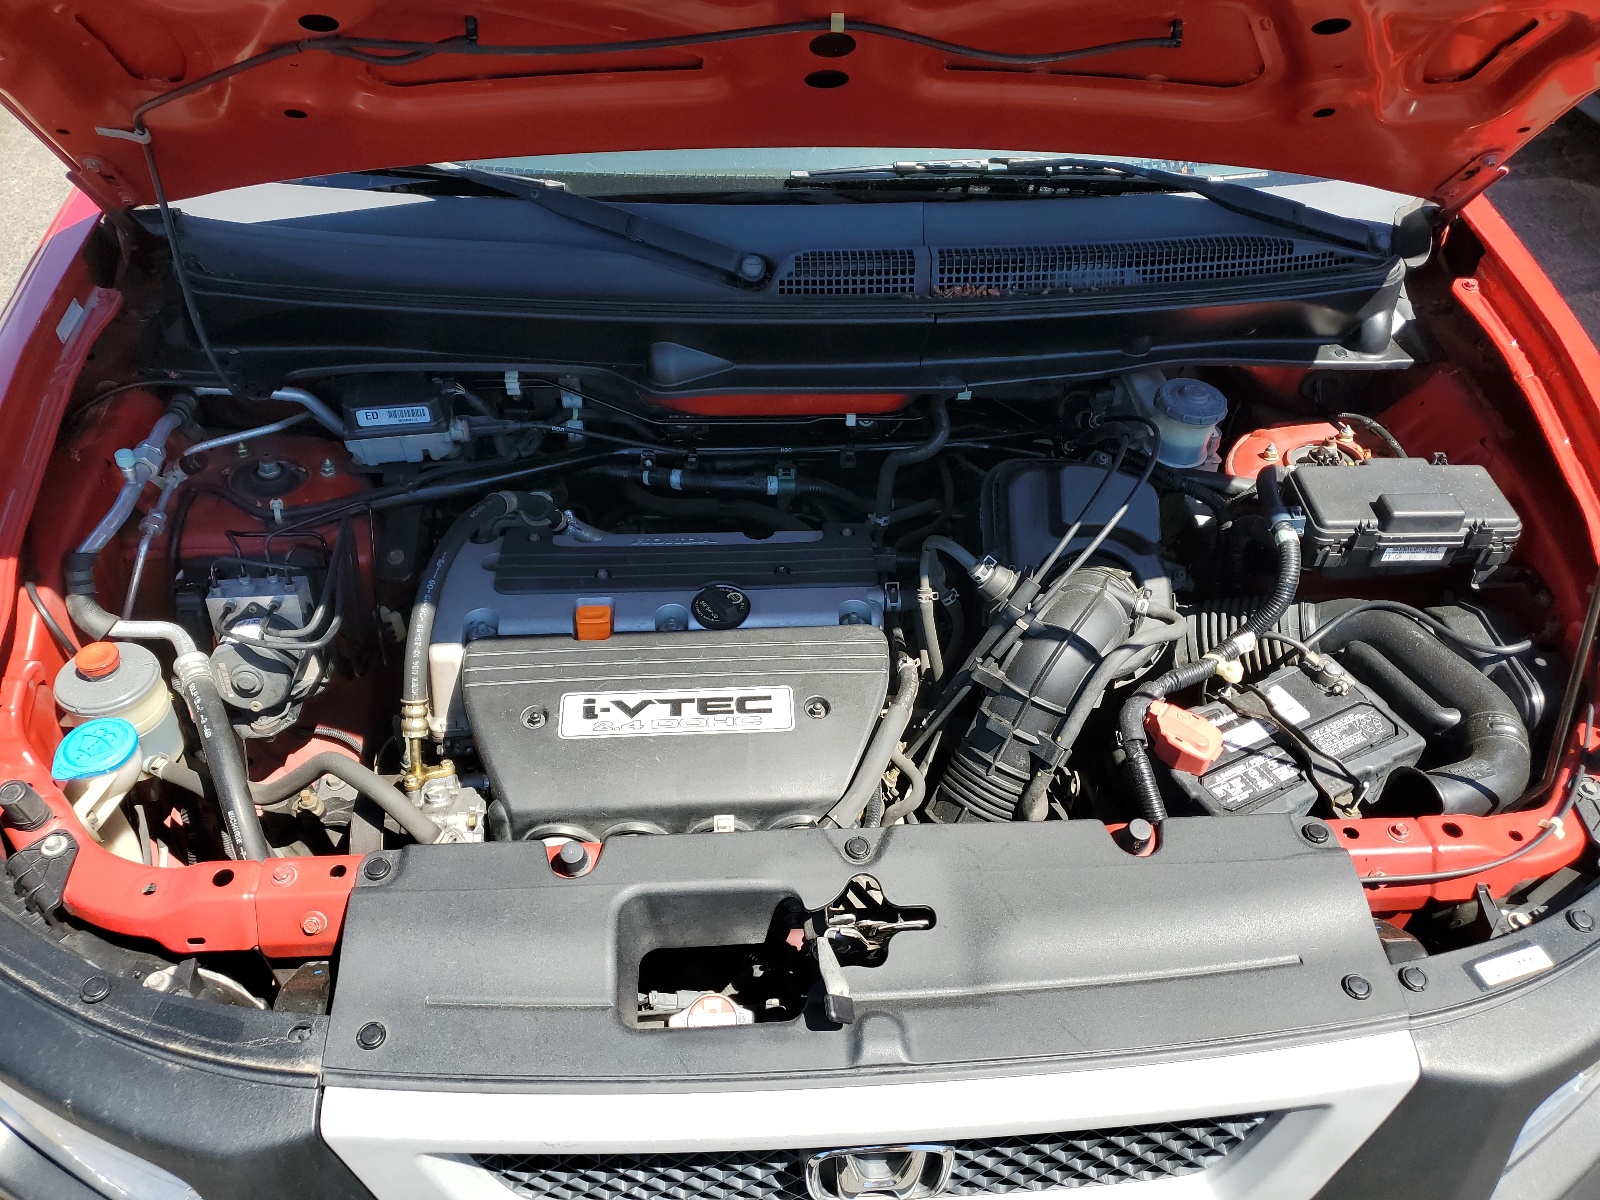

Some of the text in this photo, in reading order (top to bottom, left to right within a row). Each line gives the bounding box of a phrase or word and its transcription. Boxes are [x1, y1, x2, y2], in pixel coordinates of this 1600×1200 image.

[364, 411, 379, 420] ED
[582, 696, 772, 720] i-VTEC
[651, 715, 763, 730] DOHC
